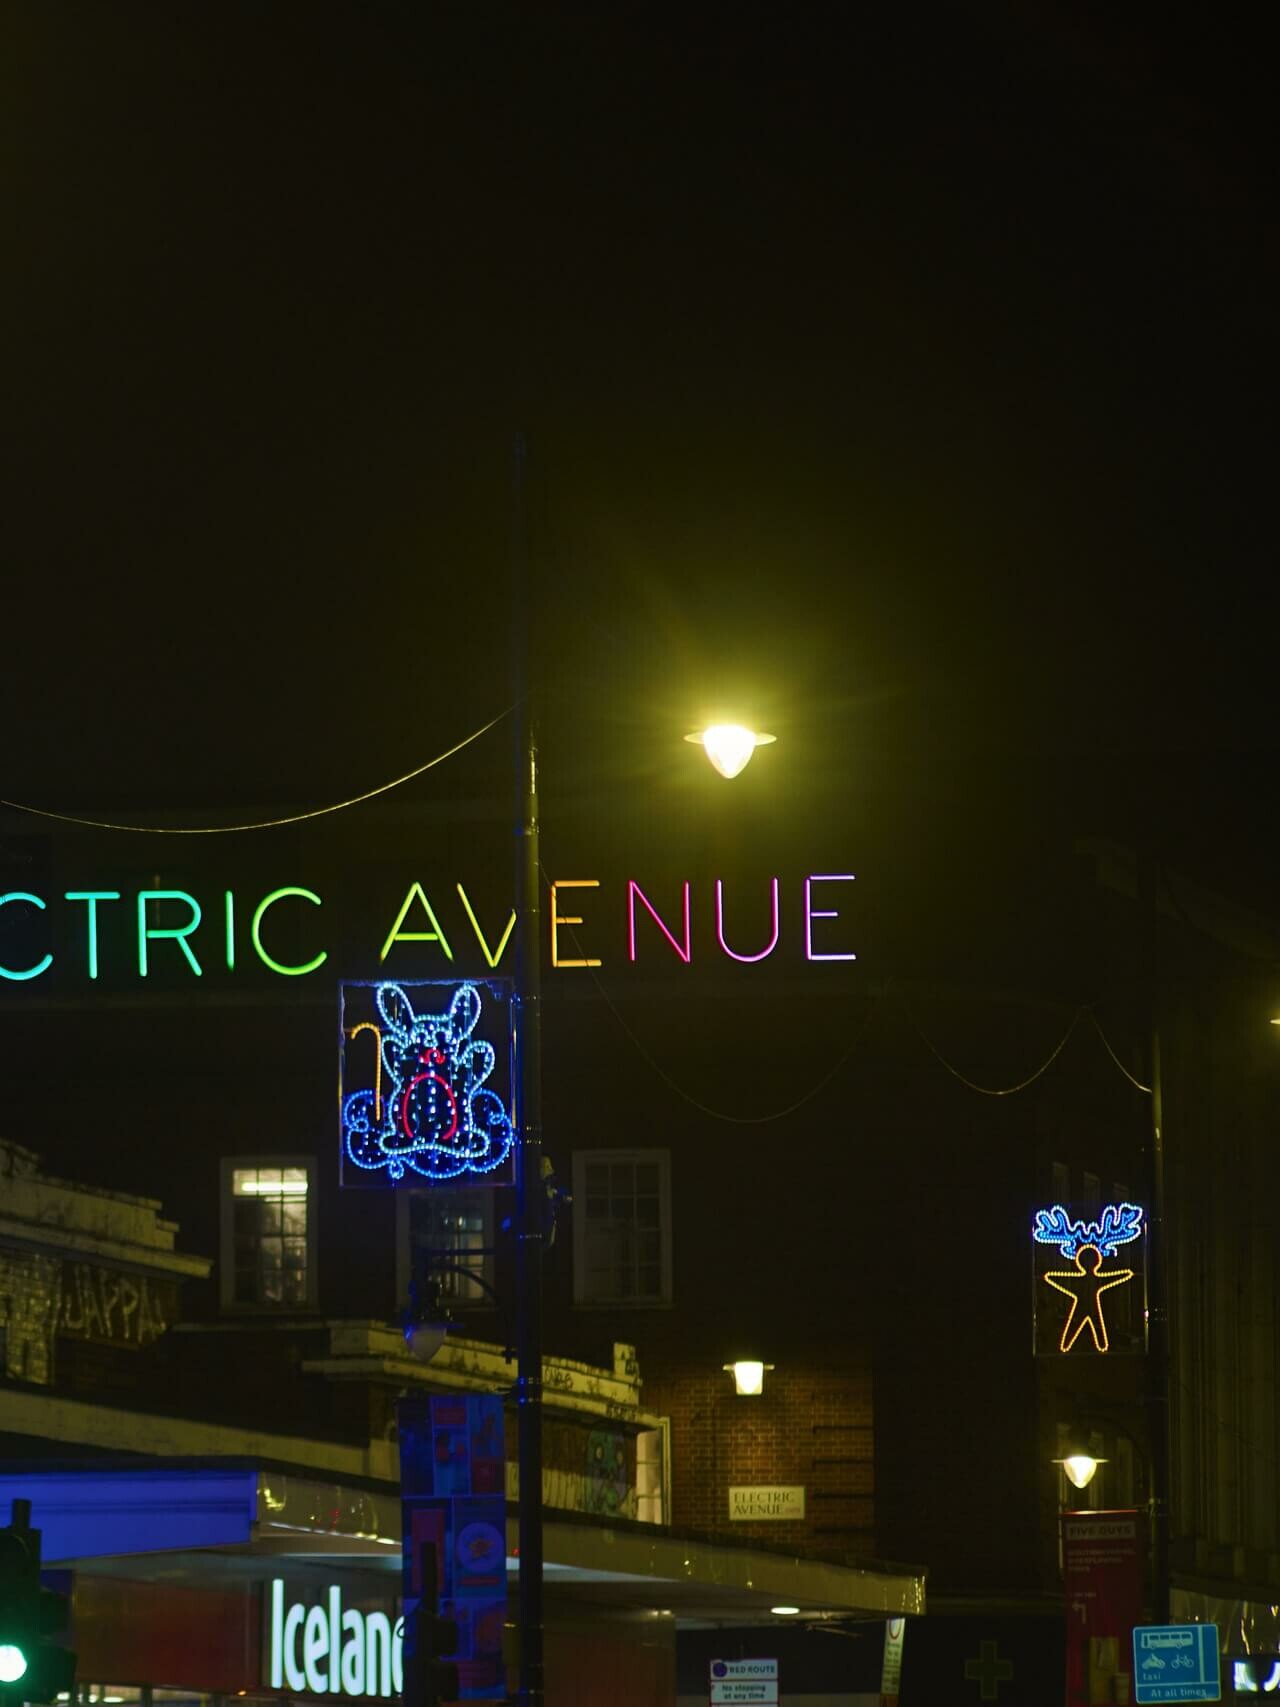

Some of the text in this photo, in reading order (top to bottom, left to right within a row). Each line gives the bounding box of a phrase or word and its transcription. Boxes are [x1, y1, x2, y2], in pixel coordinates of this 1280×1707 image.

[379, 873, 857, 968] AVENUE
[748, 1665, 775, 1673] ROUTE
[1143, 1672, 1161, 1681] taxi
[1151, 1688, 1162, 1697] At
[1165, 1687, 1178, 1697] all
